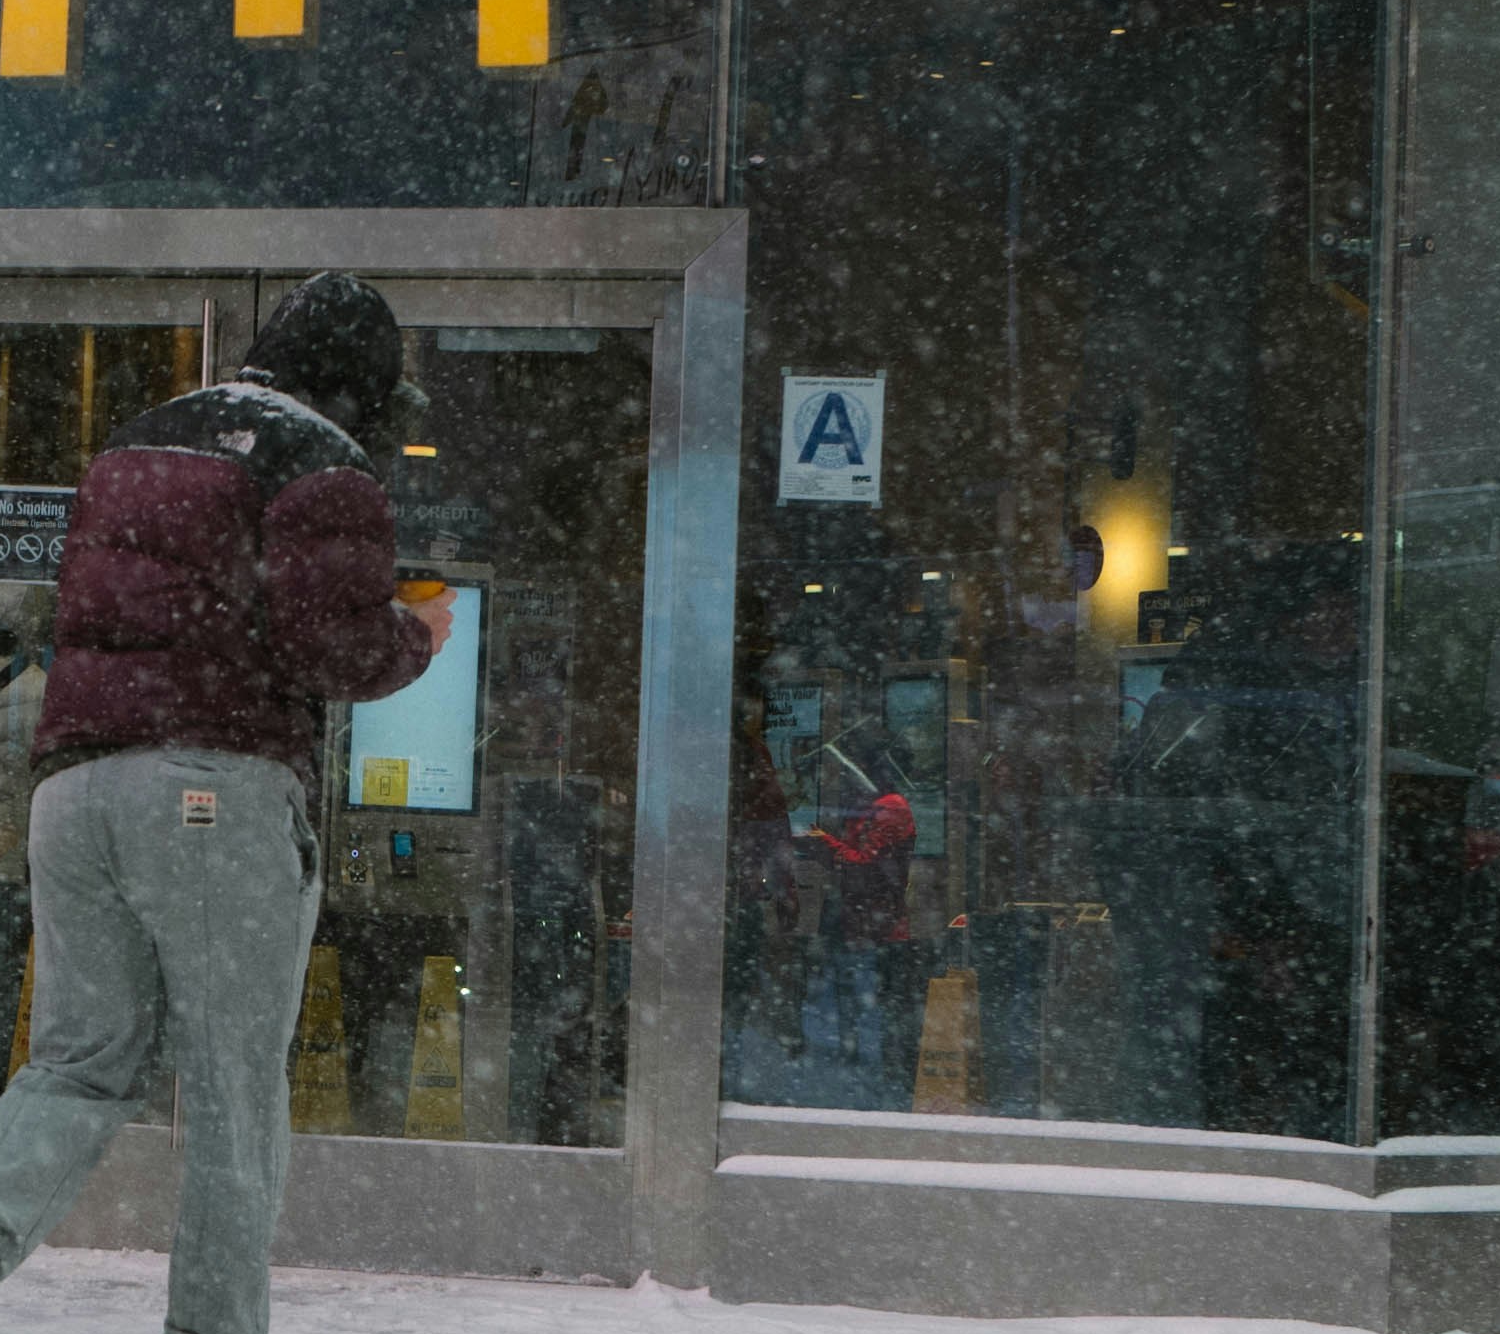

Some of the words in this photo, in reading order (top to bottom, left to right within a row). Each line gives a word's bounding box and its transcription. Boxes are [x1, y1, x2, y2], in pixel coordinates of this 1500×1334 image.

[797, 392, 865, 465] A
[16, 500, 66, 520] Smoking
[416, 505, 481, 519] CREDIT
